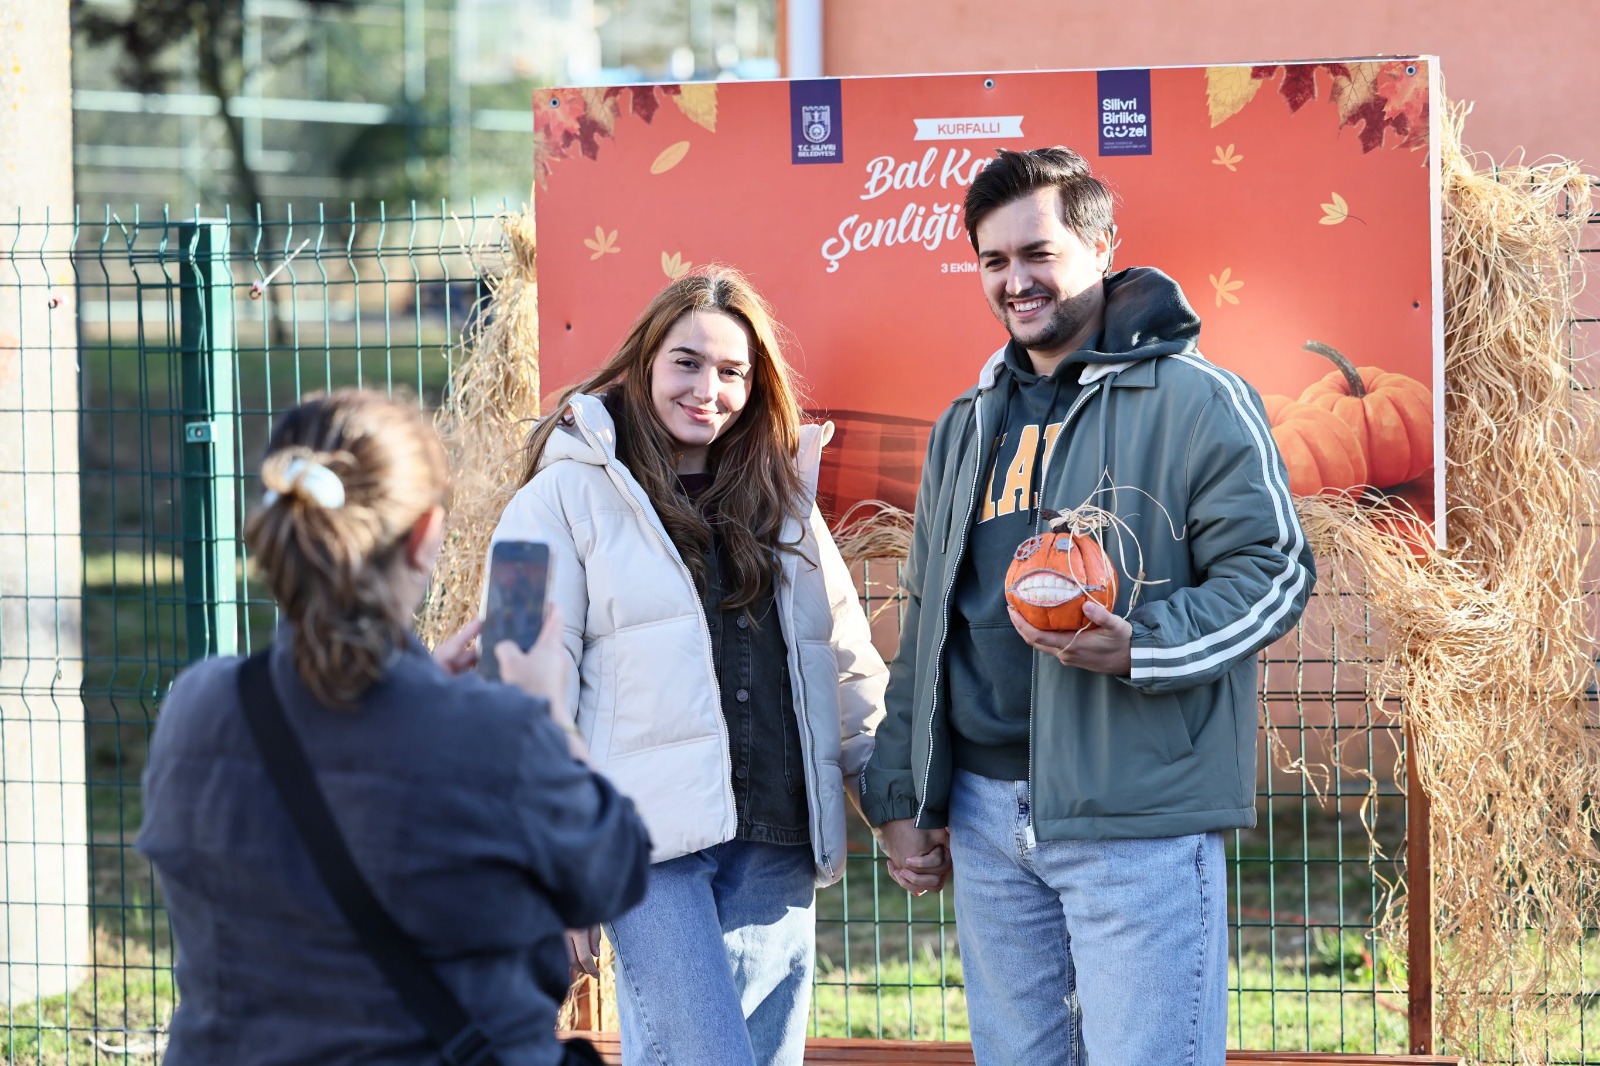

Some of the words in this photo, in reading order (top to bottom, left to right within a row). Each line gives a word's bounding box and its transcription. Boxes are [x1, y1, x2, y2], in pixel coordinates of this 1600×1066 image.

[1102, 98, 1137, 111] Silivri
[1102, 111, 1146, 124] Birlikte
[937, 122, 1001, 135] KURFALLI
[860, 146, 937, 201] Bal
[821, 202, 962, 273] Şenliği
[940, 263, 948, 273] 3
[950, 261, 977, 273] EKİM
